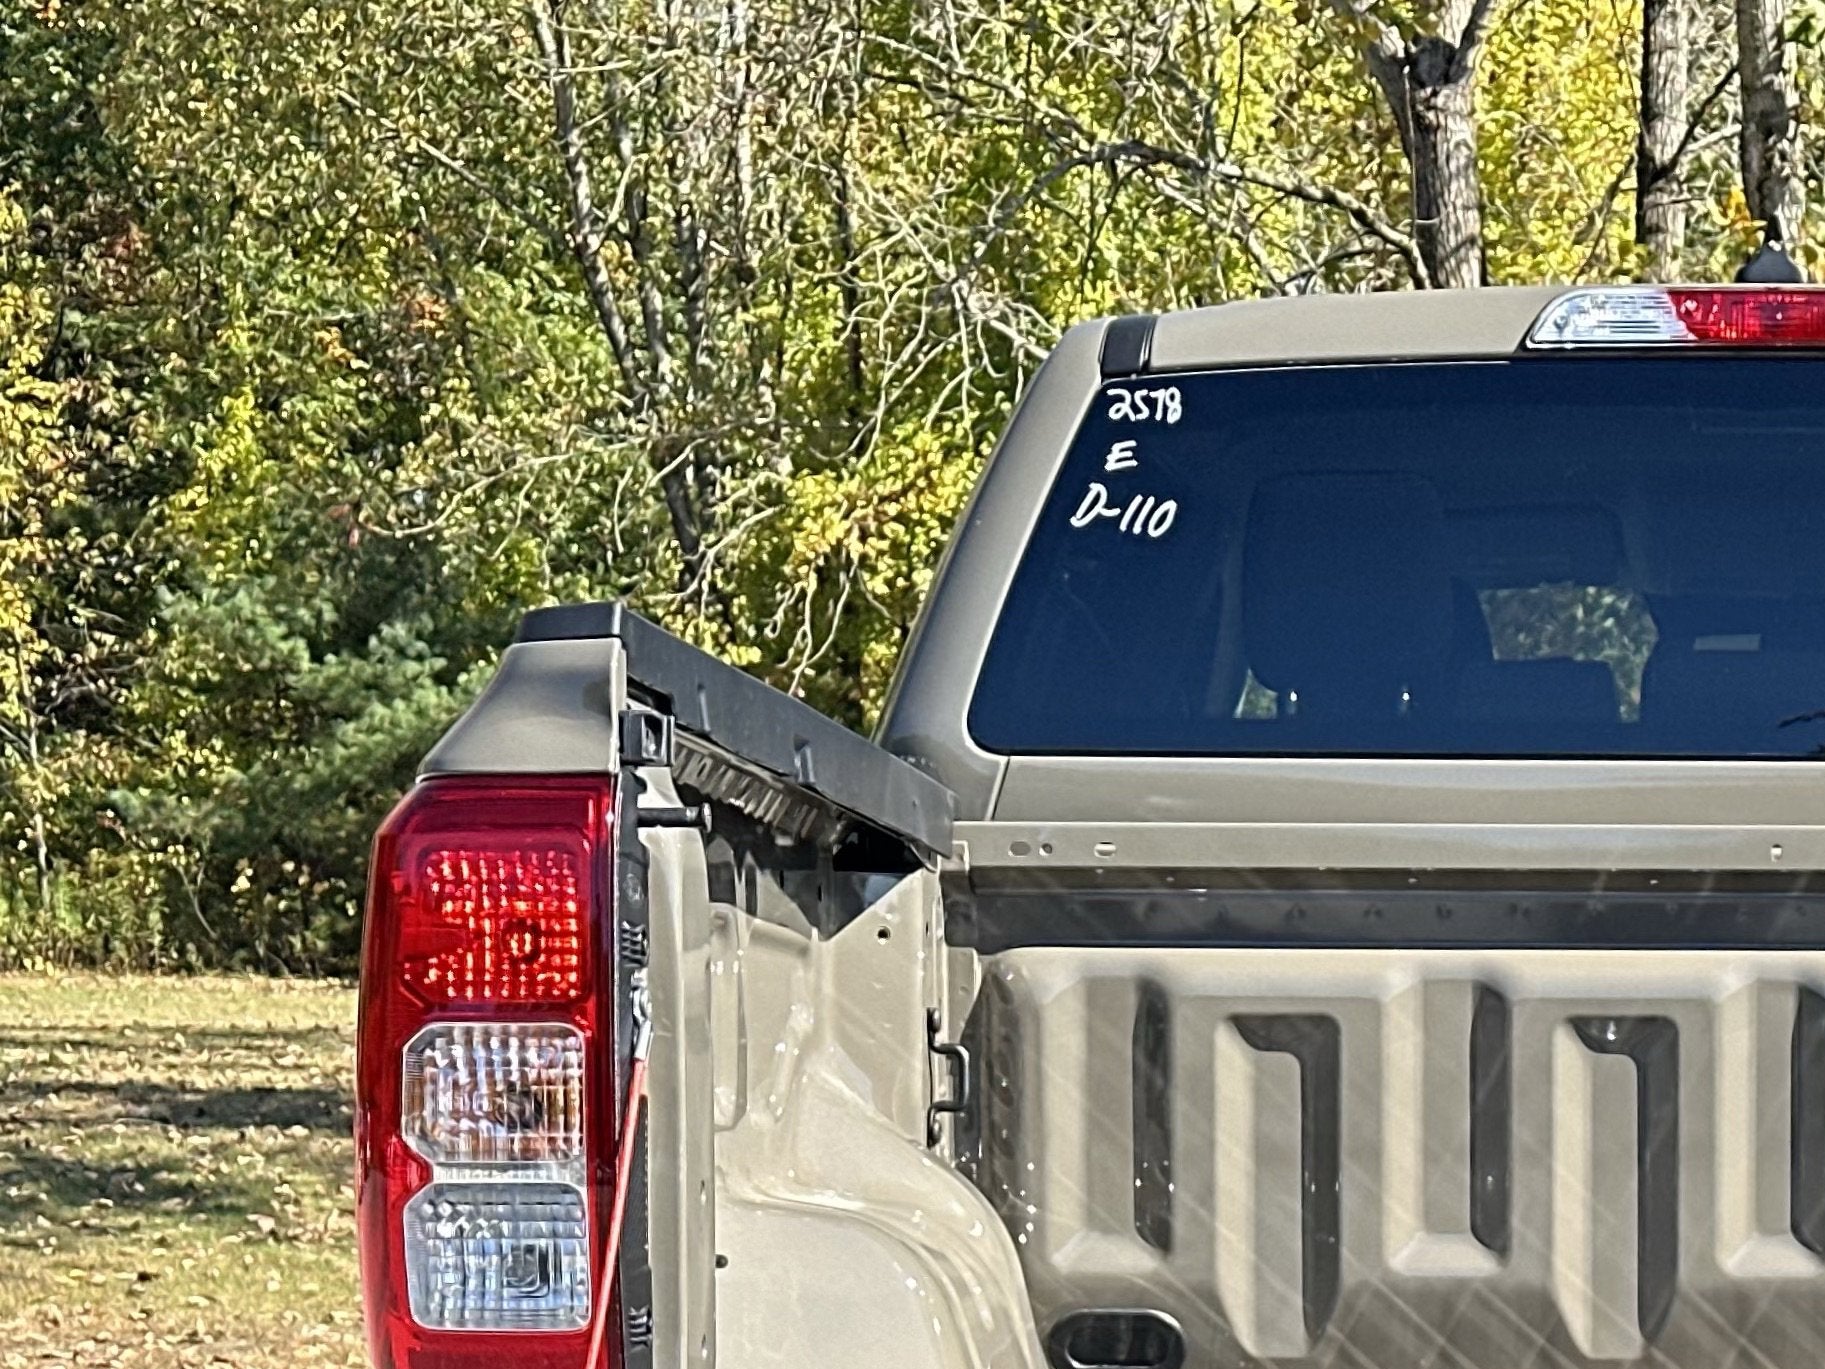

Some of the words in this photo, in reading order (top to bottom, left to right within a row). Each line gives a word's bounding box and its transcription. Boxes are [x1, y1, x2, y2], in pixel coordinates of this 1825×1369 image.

[1106, 386, 1182, 424] 2578
[1104, 440, 1138, 472] E
[1069, 482, 1178, 538] D-110
